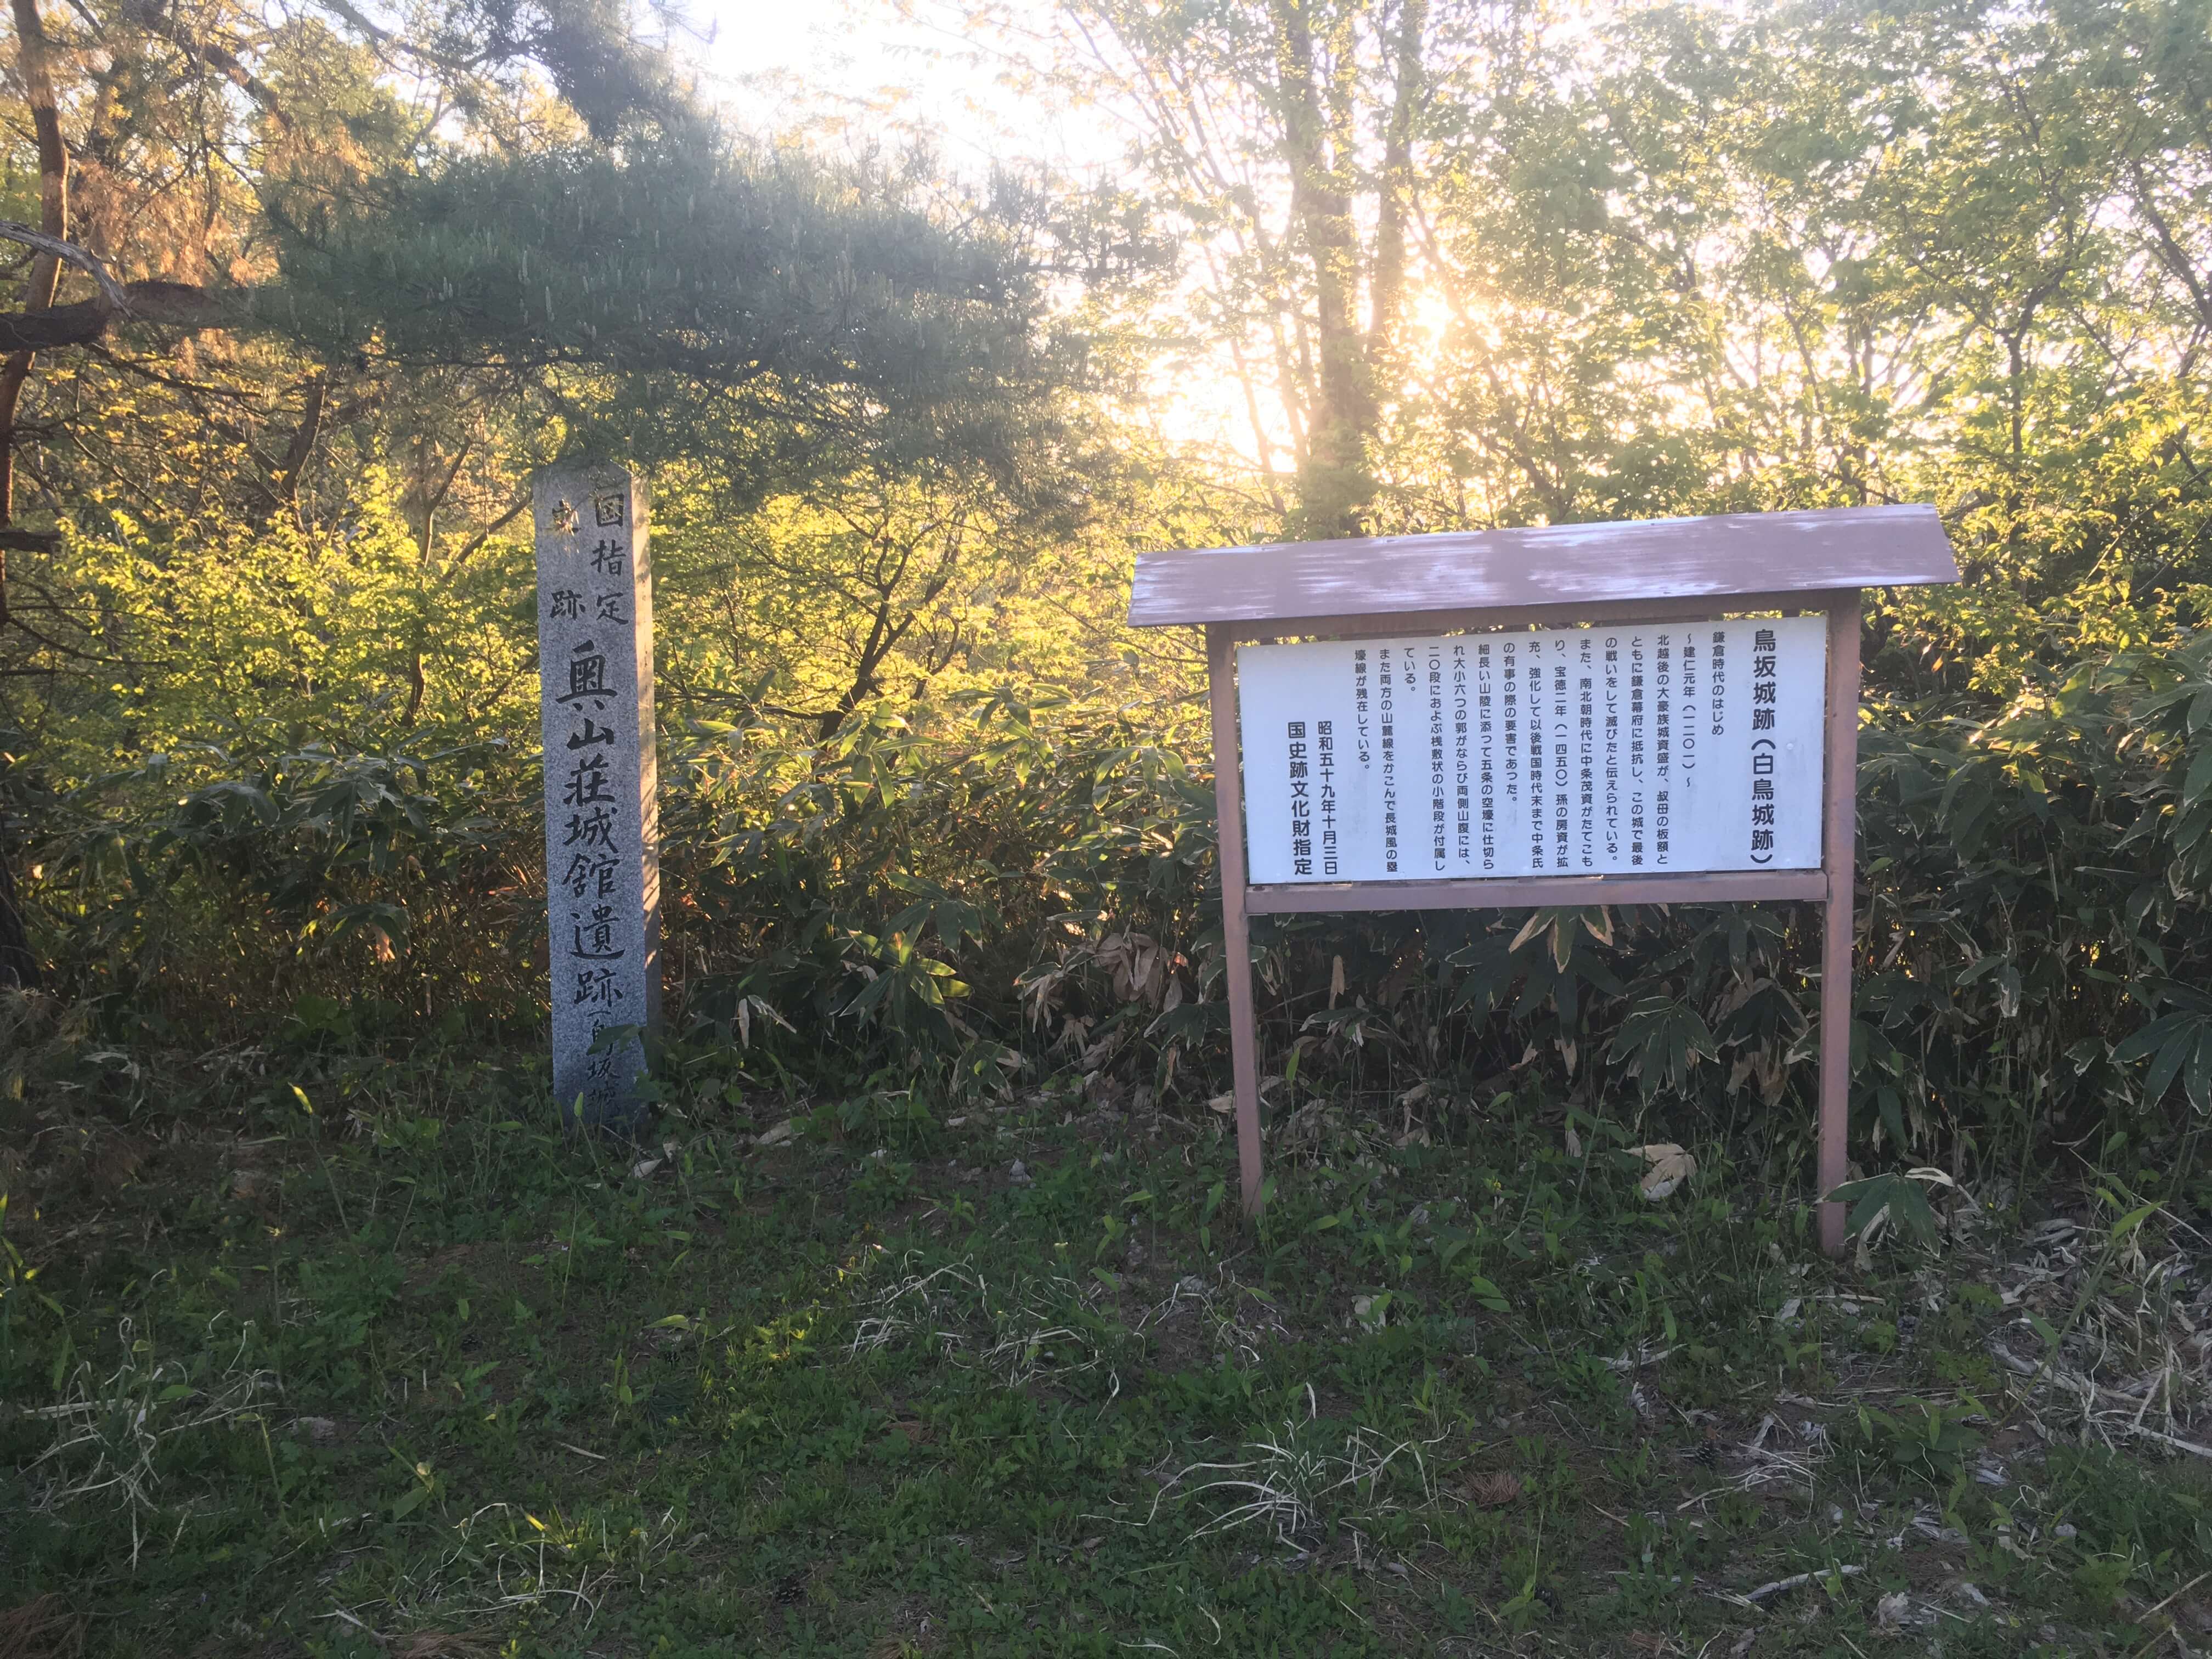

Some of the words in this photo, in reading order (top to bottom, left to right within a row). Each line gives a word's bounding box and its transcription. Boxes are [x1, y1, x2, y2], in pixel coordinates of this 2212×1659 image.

[1404, 648, 1416, 691] ている。
[1454, 645, 1470, 864] れ大小六つの郭がならび両側山腹には、
[1529, 641, 1543, 868] 充、強化して以後戦国時代末まで中条氏
[1580, 639, 1593, 866] また、南北朝時代に中条茂資がたてこも
[1606, 637, 1618, 860] の戦いをして滅びたと伝えられている。
[1632, 636, 1643, 865] ともに鎌倉幕府に抵抗し、この城で最後
[1712, 631, 1725, 735] 鎌倉時代のはじめ
[1751, 629, 1776, 864] 鳥坂城跡（白鳥城跡）
[1288, 721, 1312, 875] 国史跡文化財指定
[1318, 721, 1338, 874] 昭和五十九年十月三日
